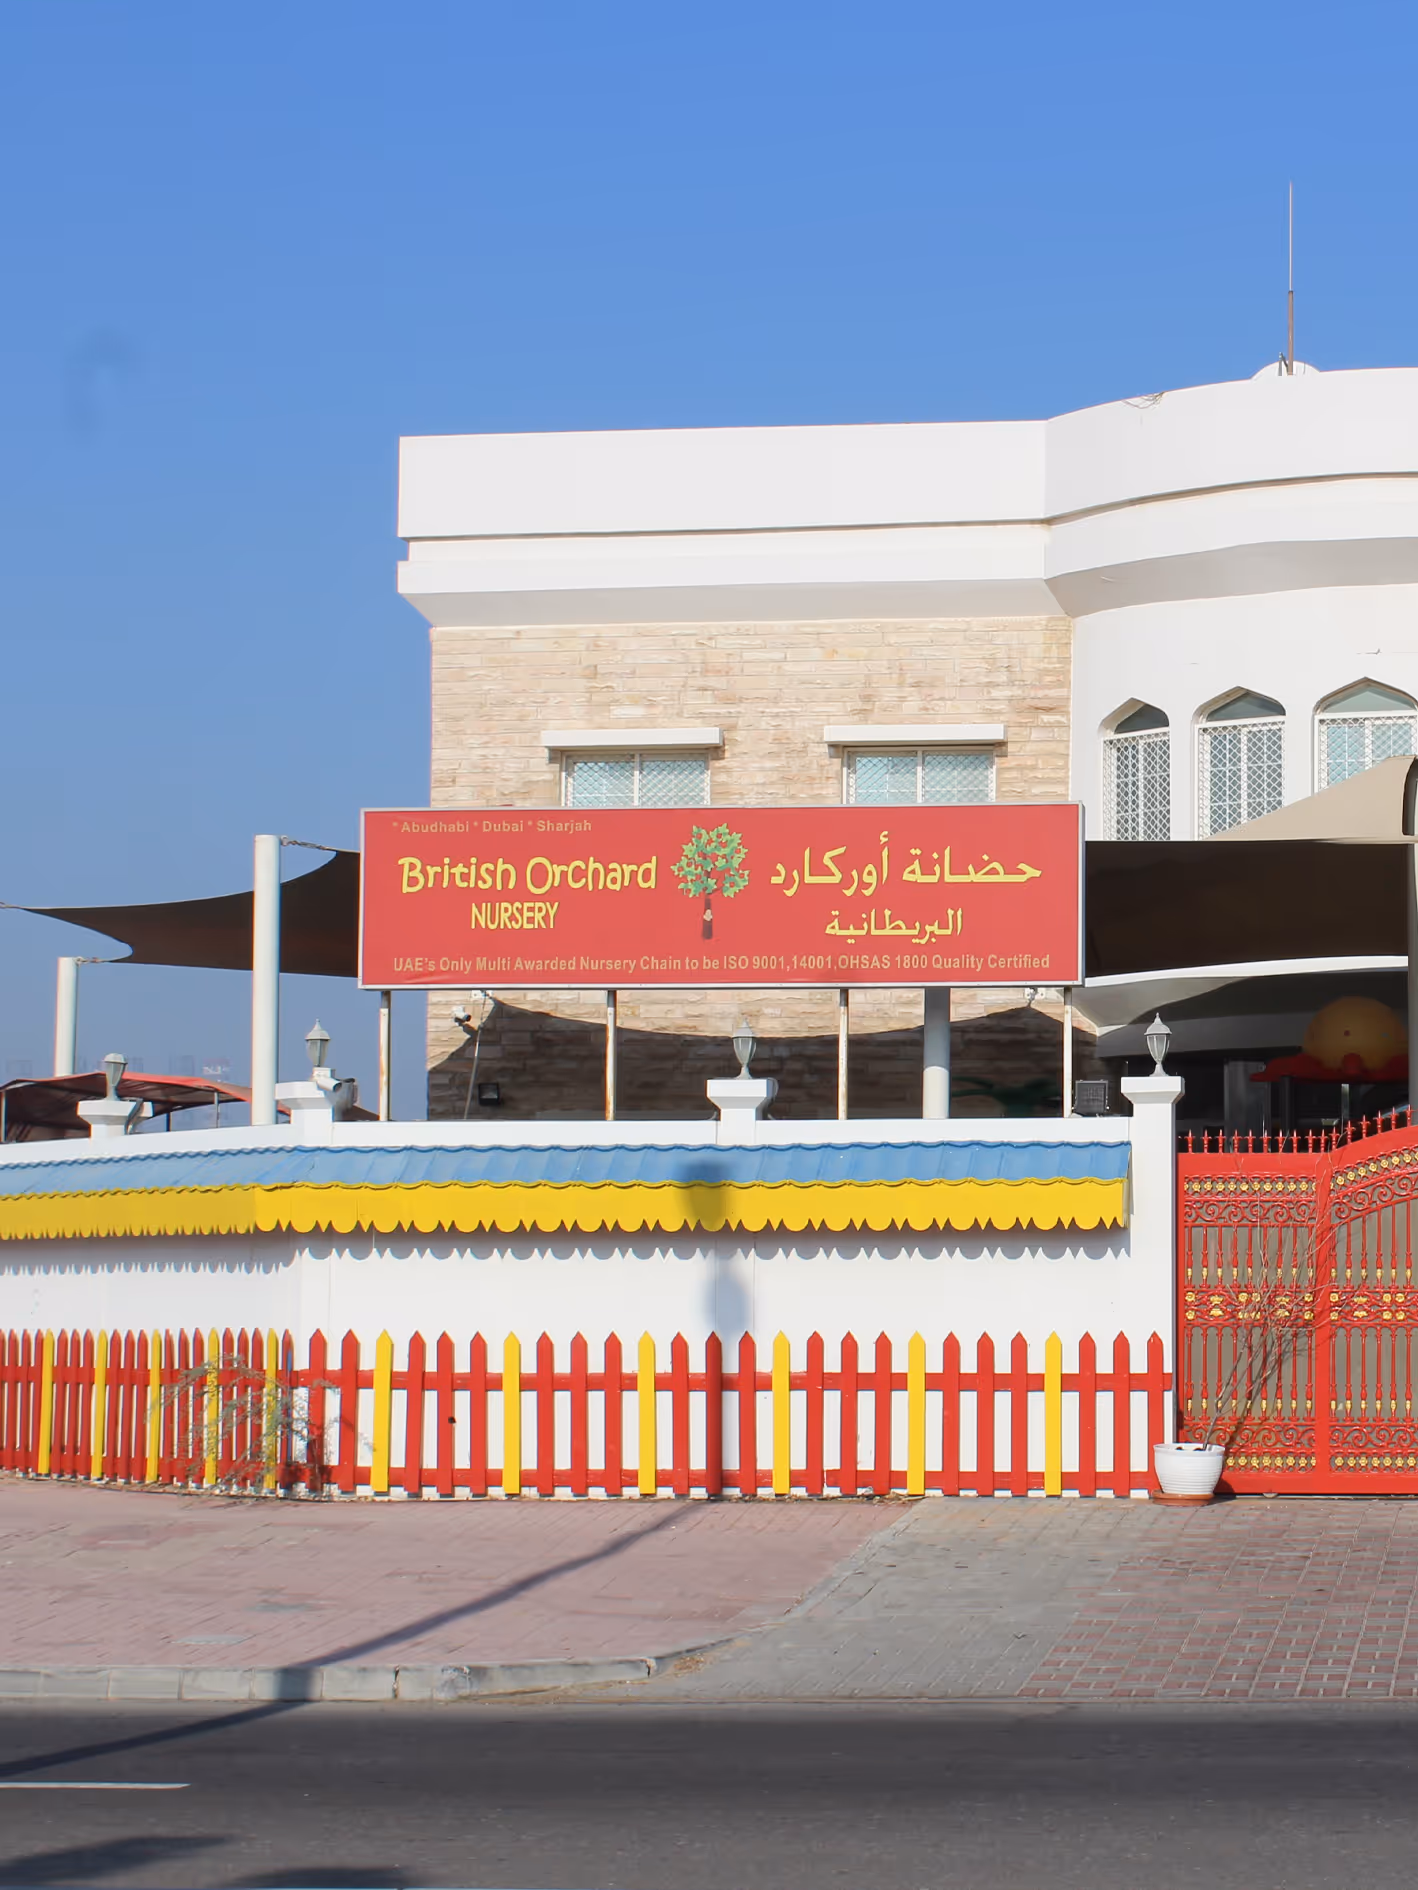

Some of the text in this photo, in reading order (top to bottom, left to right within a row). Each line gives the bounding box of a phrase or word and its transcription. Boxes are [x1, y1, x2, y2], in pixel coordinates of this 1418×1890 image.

[401, 820, 592, 835] Abudhabi Dubai Sharjah
[397, 855, 657, 895] British Orchard
[770, 830, 1043, 897] حضانة أوركارد
[470, 901, 559, 930] NURSERY
[824, 907, 963, 945] البريطانية
[439, 957, 473, 974] Only
[475, 957, 511, 971] Multi
[513, 956, 577, 971] Awarded
[579, 956, 637, 974] Nursery
[639, 956, 682, 970] Chain
[684, 957, 700, 970] to
[702, 956, 720, 970] be
[723, 956, 750, 970] ISO
[894, 955, 928, 969] 1800
[931, 954, 985, 973] Quality
[987, 953, 1050, 969] Certified
